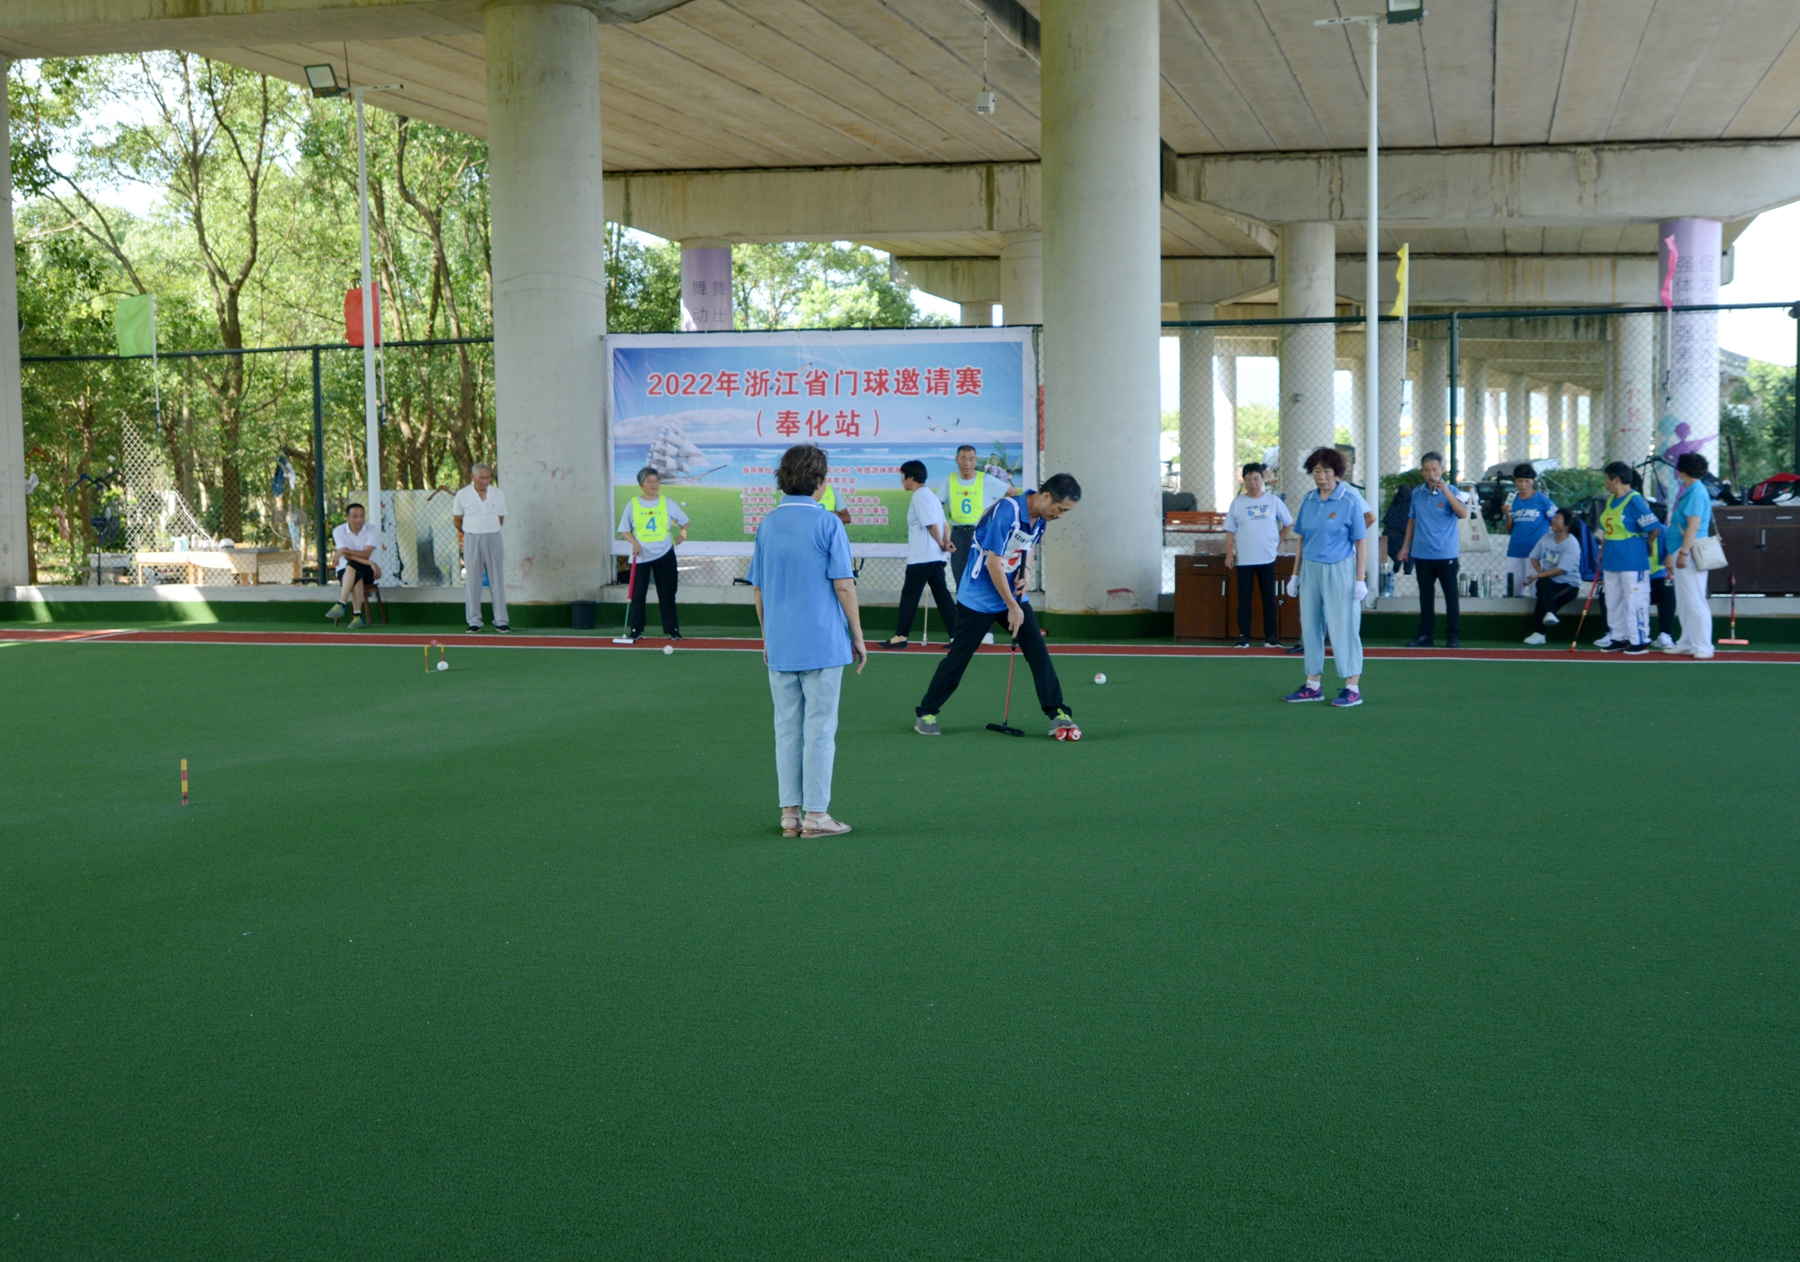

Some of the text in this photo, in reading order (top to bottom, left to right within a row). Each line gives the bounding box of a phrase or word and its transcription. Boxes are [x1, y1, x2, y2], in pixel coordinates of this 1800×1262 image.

[691, 280, 708, 323] 舞动
[712, 280, 727, 323] 舞出
[648, 366, 982, 397] 2022年浙江省门球邀请赛
[961, 498, 972, 514] 6
[646, 517, 657, 532] 4
[1605, 518, 1615, 535] 5
[1072, 729, 1082, 741] 5
